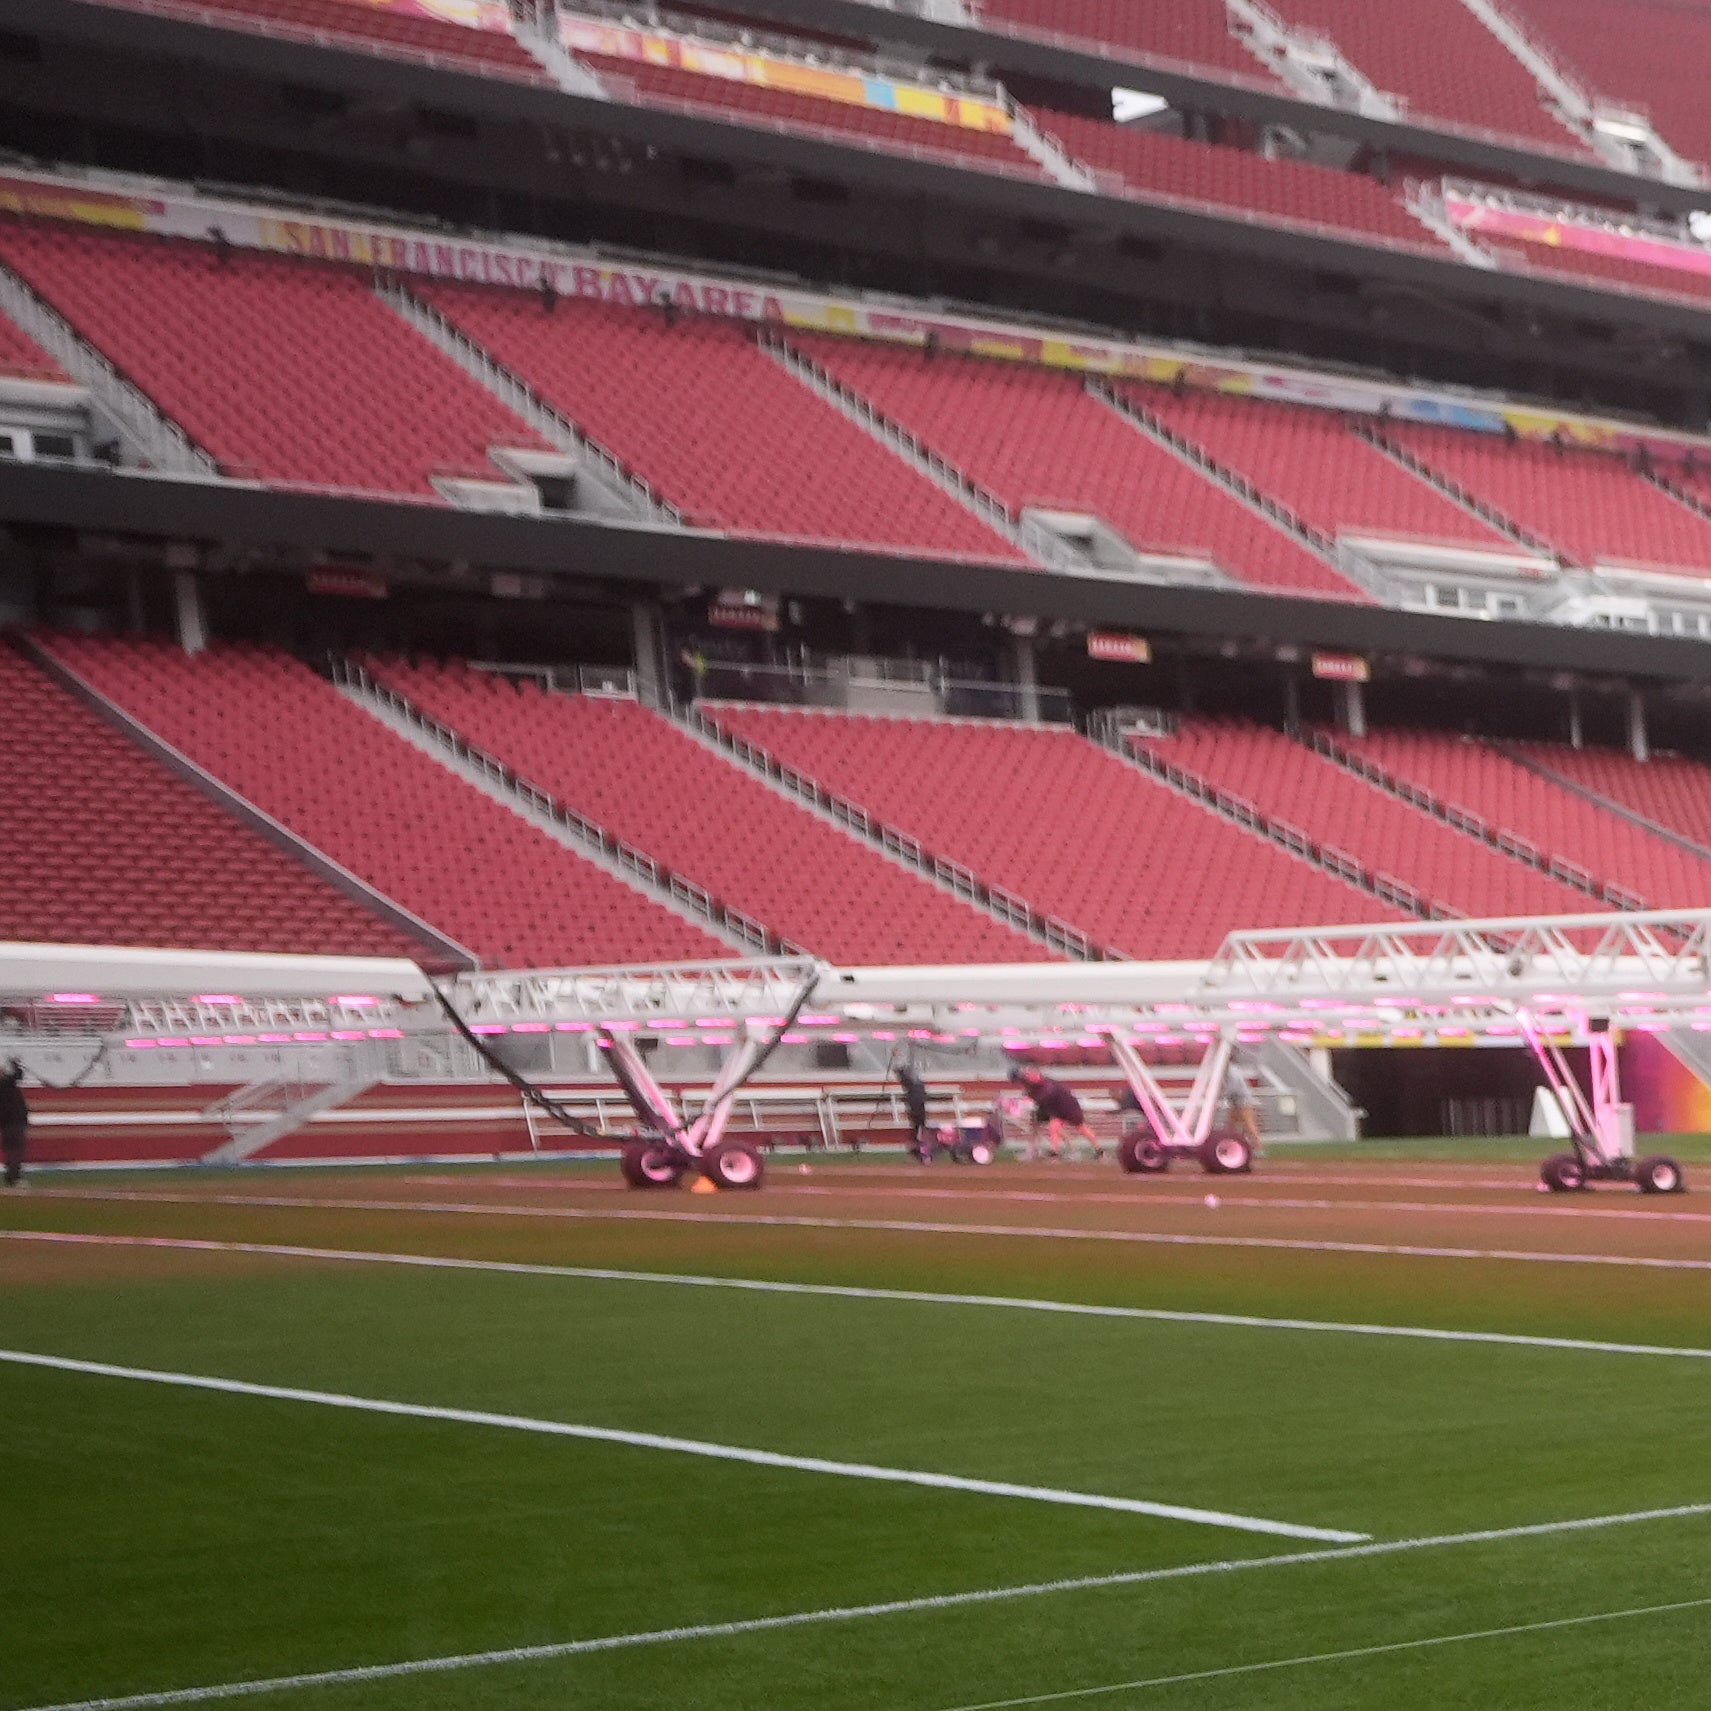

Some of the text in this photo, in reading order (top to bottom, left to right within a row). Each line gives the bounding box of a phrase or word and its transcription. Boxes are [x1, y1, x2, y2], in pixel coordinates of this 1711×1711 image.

[283, 219, 787, 324] SAN FRANCISCO BAY AREA
